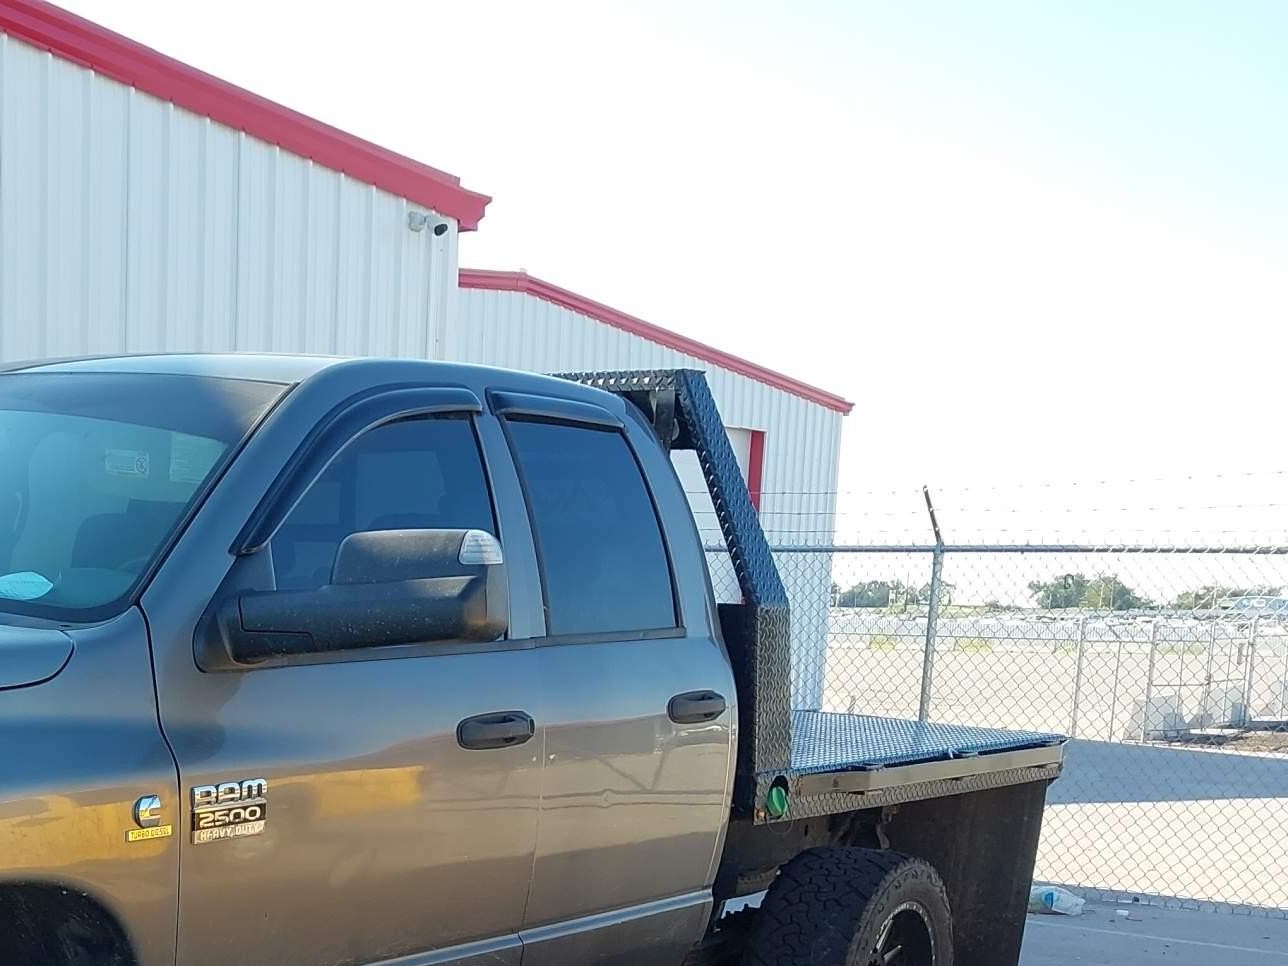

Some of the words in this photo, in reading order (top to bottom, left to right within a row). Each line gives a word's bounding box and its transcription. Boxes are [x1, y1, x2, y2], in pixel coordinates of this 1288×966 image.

[192, 778, 268, 807] RAM
[199, 806, 261, 828] 2500
[200, 826, 233, 842] HEAVY
[235, 822, 264, 837] DUTY
